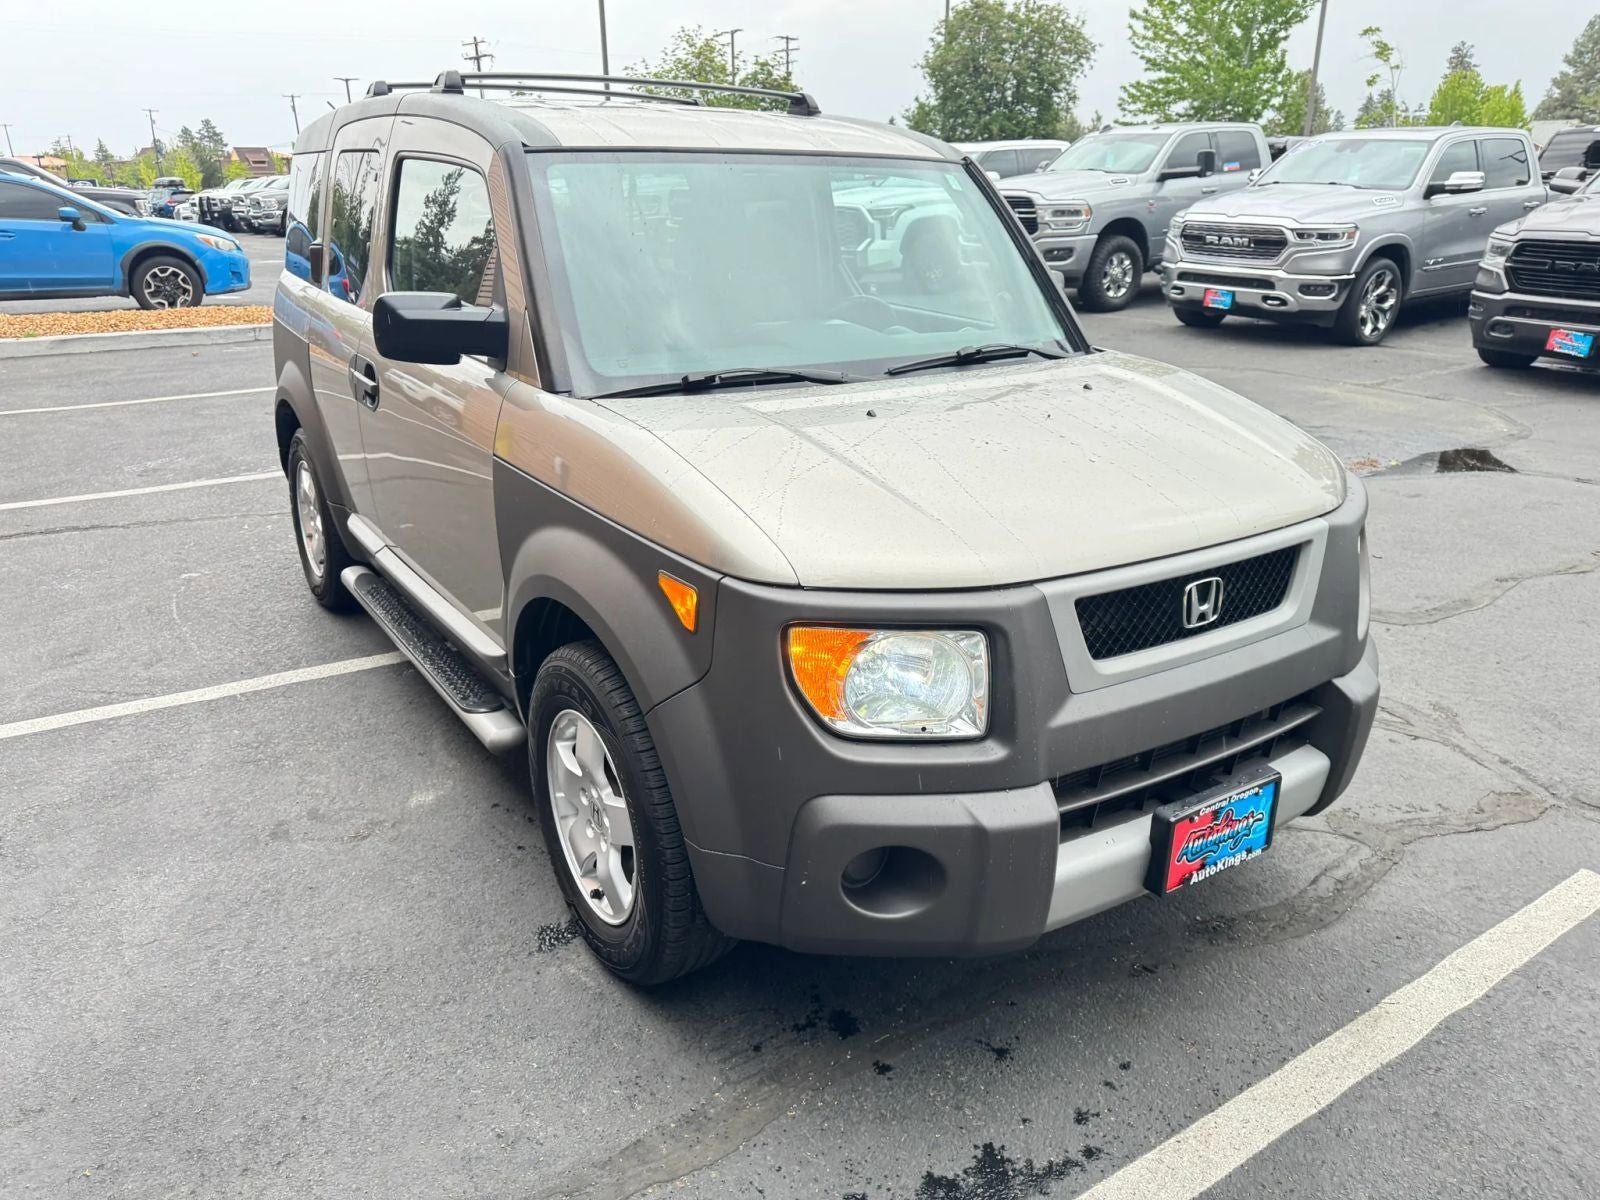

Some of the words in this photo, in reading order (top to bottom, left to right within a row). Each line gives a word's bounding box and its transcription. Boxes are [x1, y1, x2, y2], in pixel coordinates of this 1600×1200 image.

[1204, 235, 1250, 248] RAM
[1554, 261, 1600, 273] RA
[1199, 798, 1229, 817] Central
[1230, 787, 1260, 804] Oregon
[1189, 849, 1263, 886] AutoKings.com
